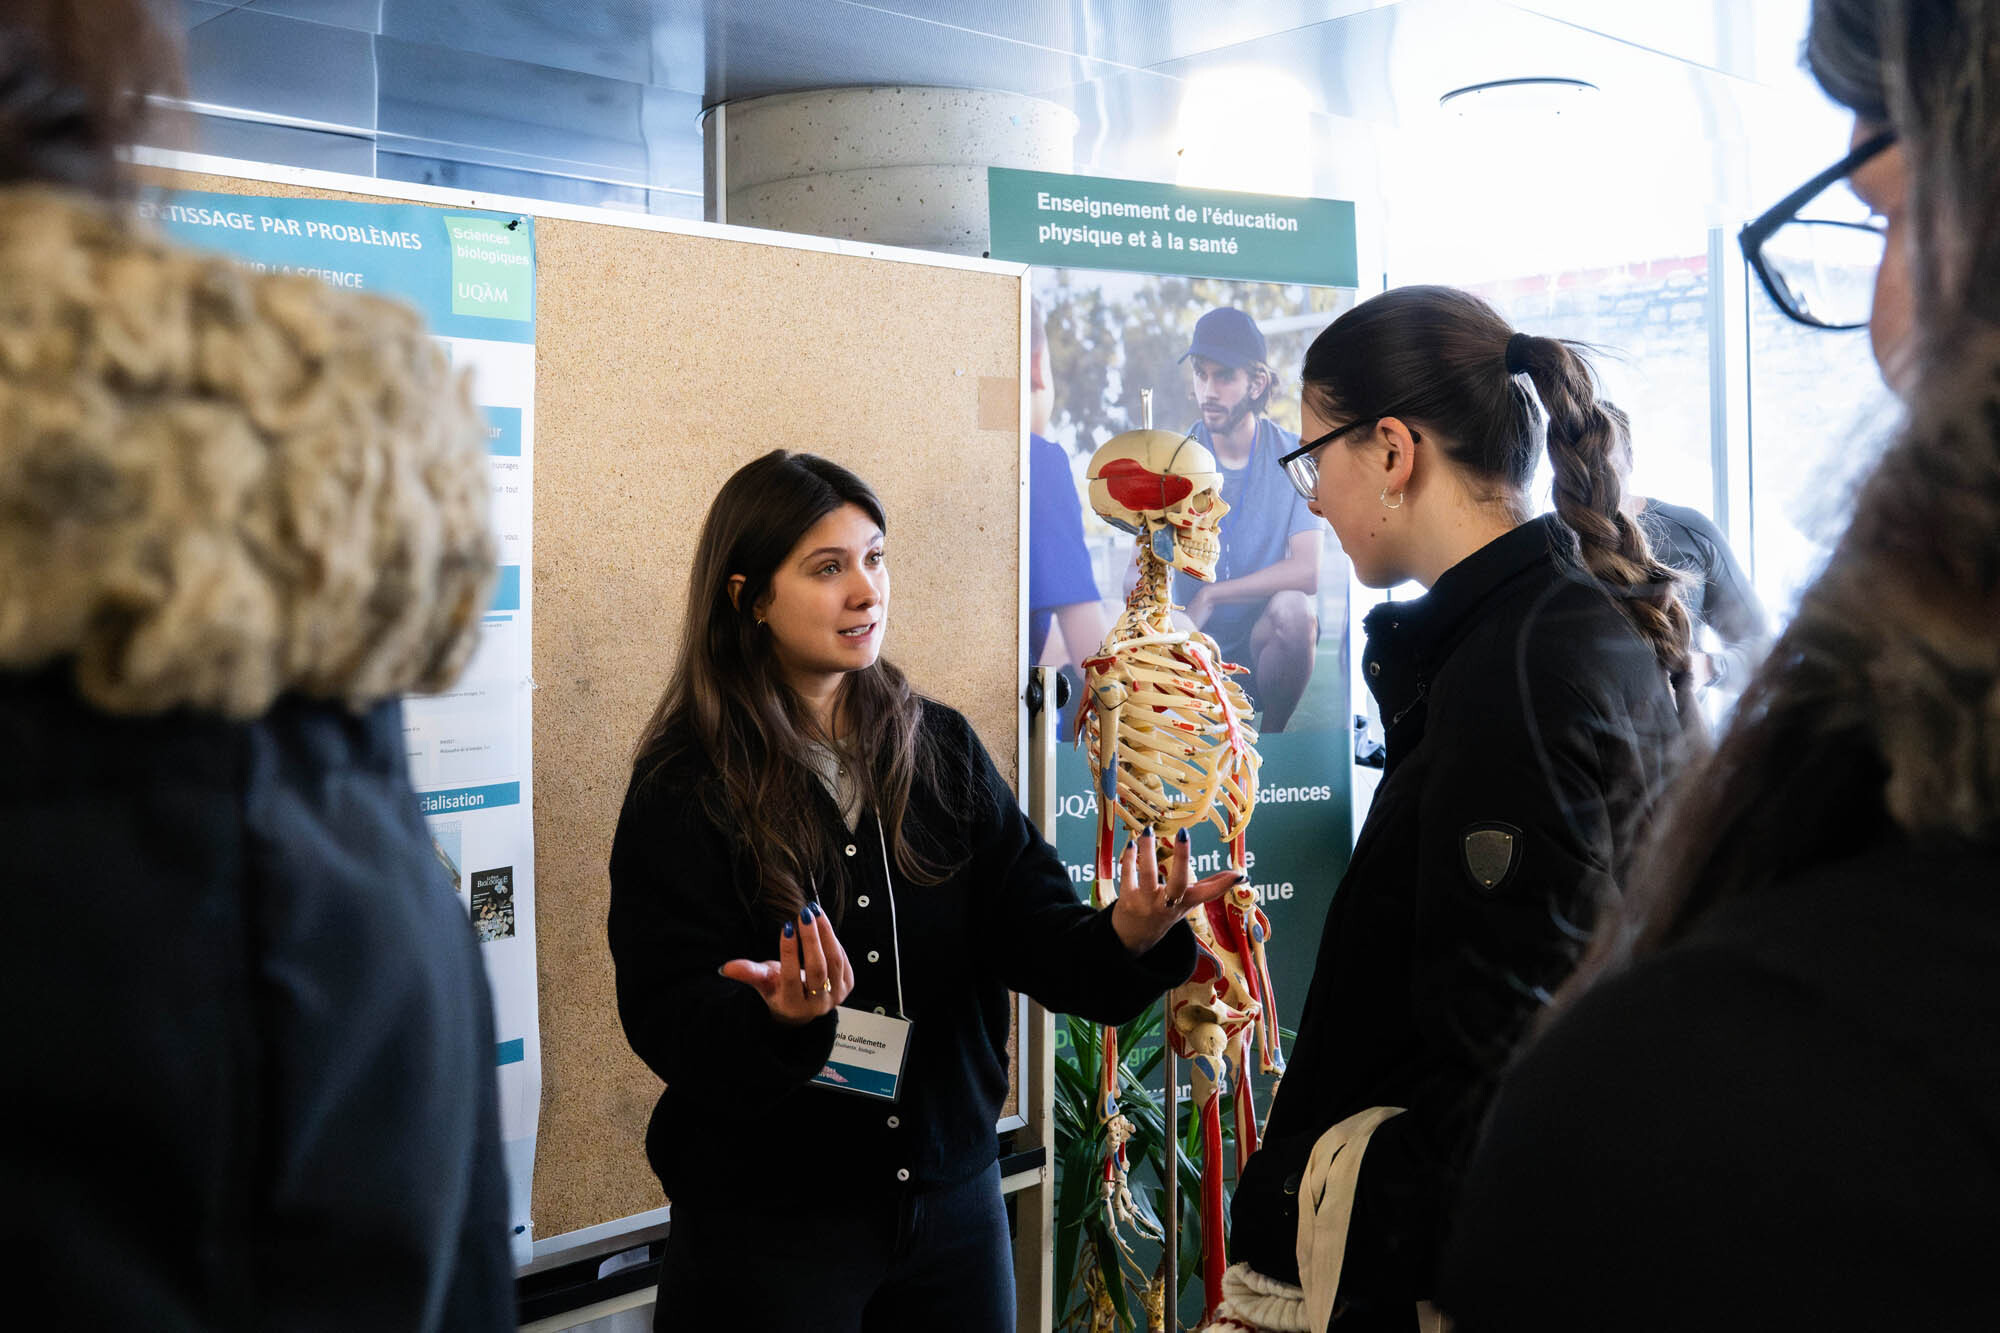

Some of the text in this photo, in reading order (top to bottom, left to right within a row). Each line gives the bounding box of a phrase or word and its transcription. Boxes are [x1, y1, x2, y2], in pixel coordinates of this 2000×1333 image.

[1037, 191, 1299, 232] Enseignement de l'éducation
[260, 216, 302, 237] PAR
[305, 221, 423, 251] PROBLÈMES
[453, 228, 510, 245] Sciences
[1038, 223, 1239, 255] physique et à la santé
[456, 244, 530, 265] biologiques
[458, 281, 509, 304] UQÀM
[420, 792, 485, 811] cialisation
[848, 1034, 887, 1049] Guillemette
